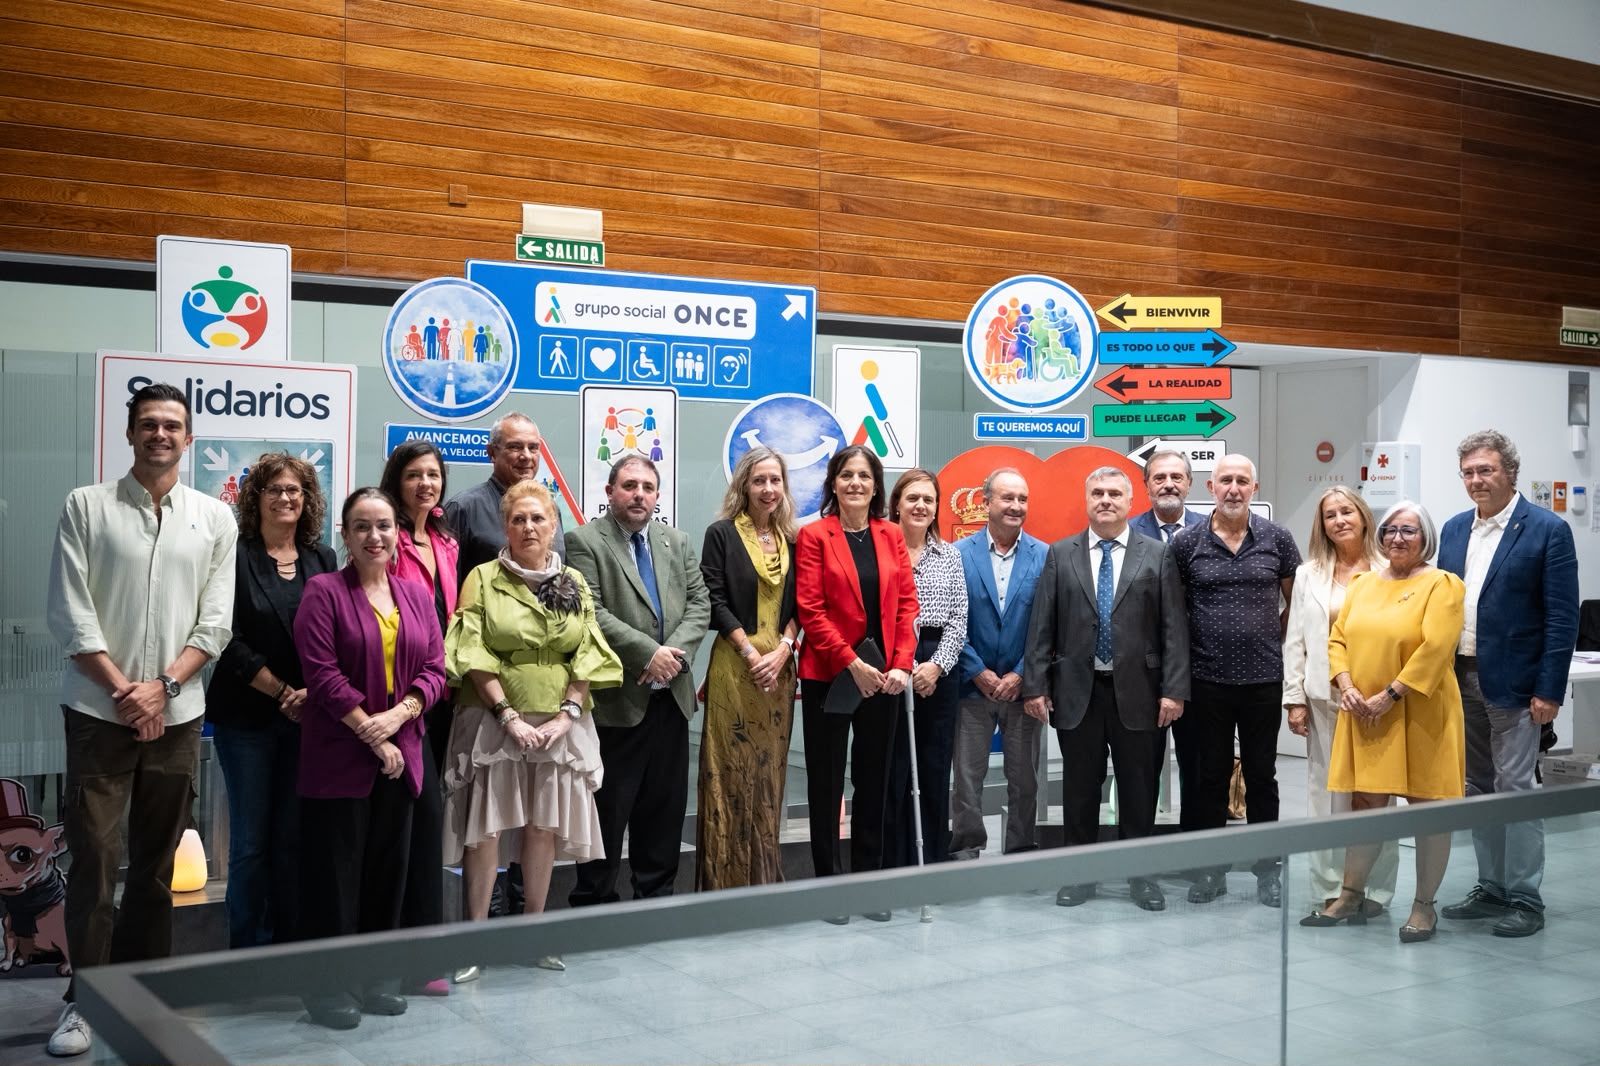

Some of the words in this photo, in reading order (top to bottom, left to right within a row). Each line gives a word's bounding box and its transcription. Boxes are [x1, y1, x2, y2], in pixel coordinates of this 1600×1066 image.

[545, 241, 599, 262] SALIDA
[574, 302, 621, 318] grupo
[623, 304, 666, 319] social
[673, 304, 748, 328] ONCE
[1146, 308, 1210, 317] BIENVIVIR
[1562, 330, 1588, 344] SALIDA
[1107, 344, 1120, 352] ES
[1122, 344, 1153, 352] TODO
[1156, 344, 1170, 352] LO
[1173, 344, 1196, 353] QUE
[1148, 380, 1162, 388] LA
[1166, 380, 1222, 388] REALIDAD
[126, 376, 330, 420] Slidarios
[1104, 414, 1141, 424] PUEDE
[1144, 414, 1186, 422] LLEGAR
[982, 422, 995, 432] TE
[996, 422, 1053, 434] QUEREMOS
[1055, 421, 1080, 434] AQUÍ
[405, 430, 489, 446] AVANCEMOS
[450, 448, 488, 458] VELOCID
[1191, 451, 1215, 460] SER
